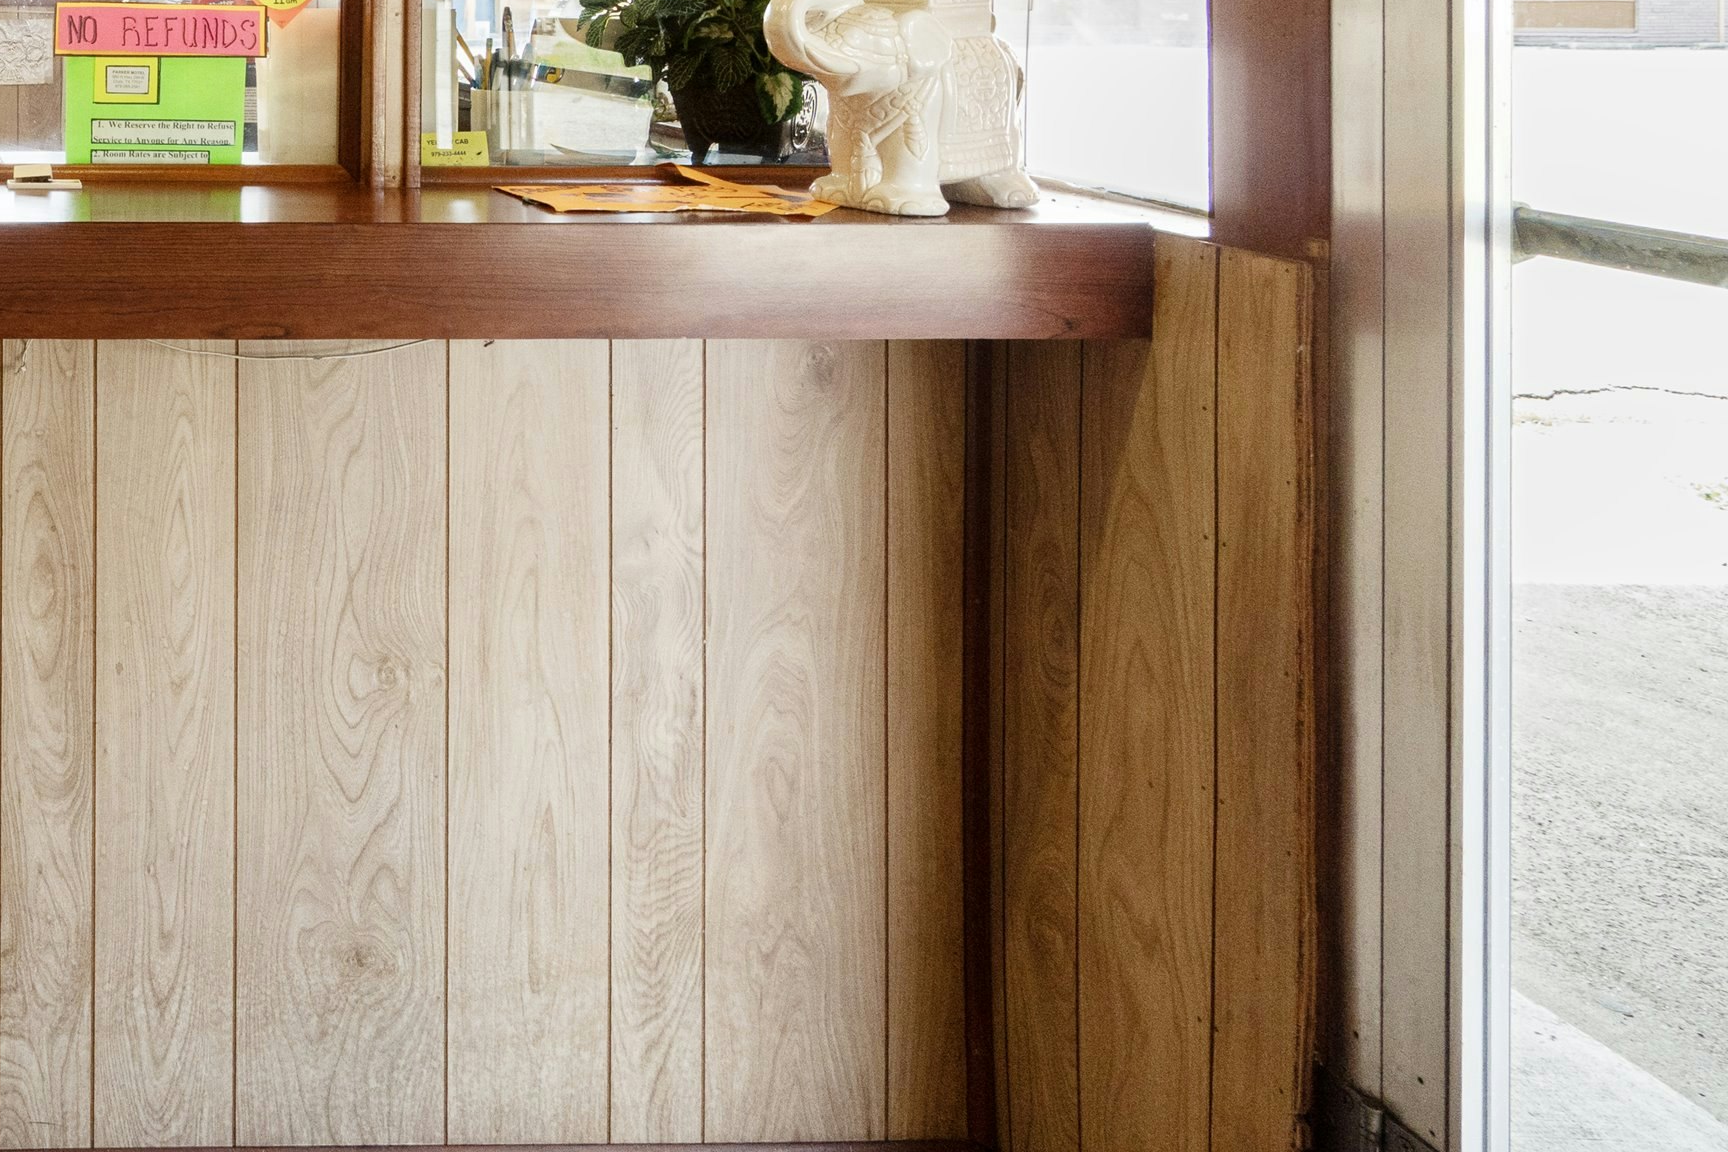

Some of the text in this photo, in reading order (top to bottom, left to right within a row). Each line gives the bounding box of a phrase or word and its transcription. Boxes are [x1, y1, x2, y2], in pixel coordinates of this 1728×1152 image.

[67, 15, 257, 50] NO REFUNDS
[124, 121, 156, 129] Reserve
[173, 122, 194, 131] Right
[93, 136, 121, 144] Service
[135, 137, 165, 145] Anyone
[182, 137, 197, 145] Any
[169, 151, 198, 160] Subject
